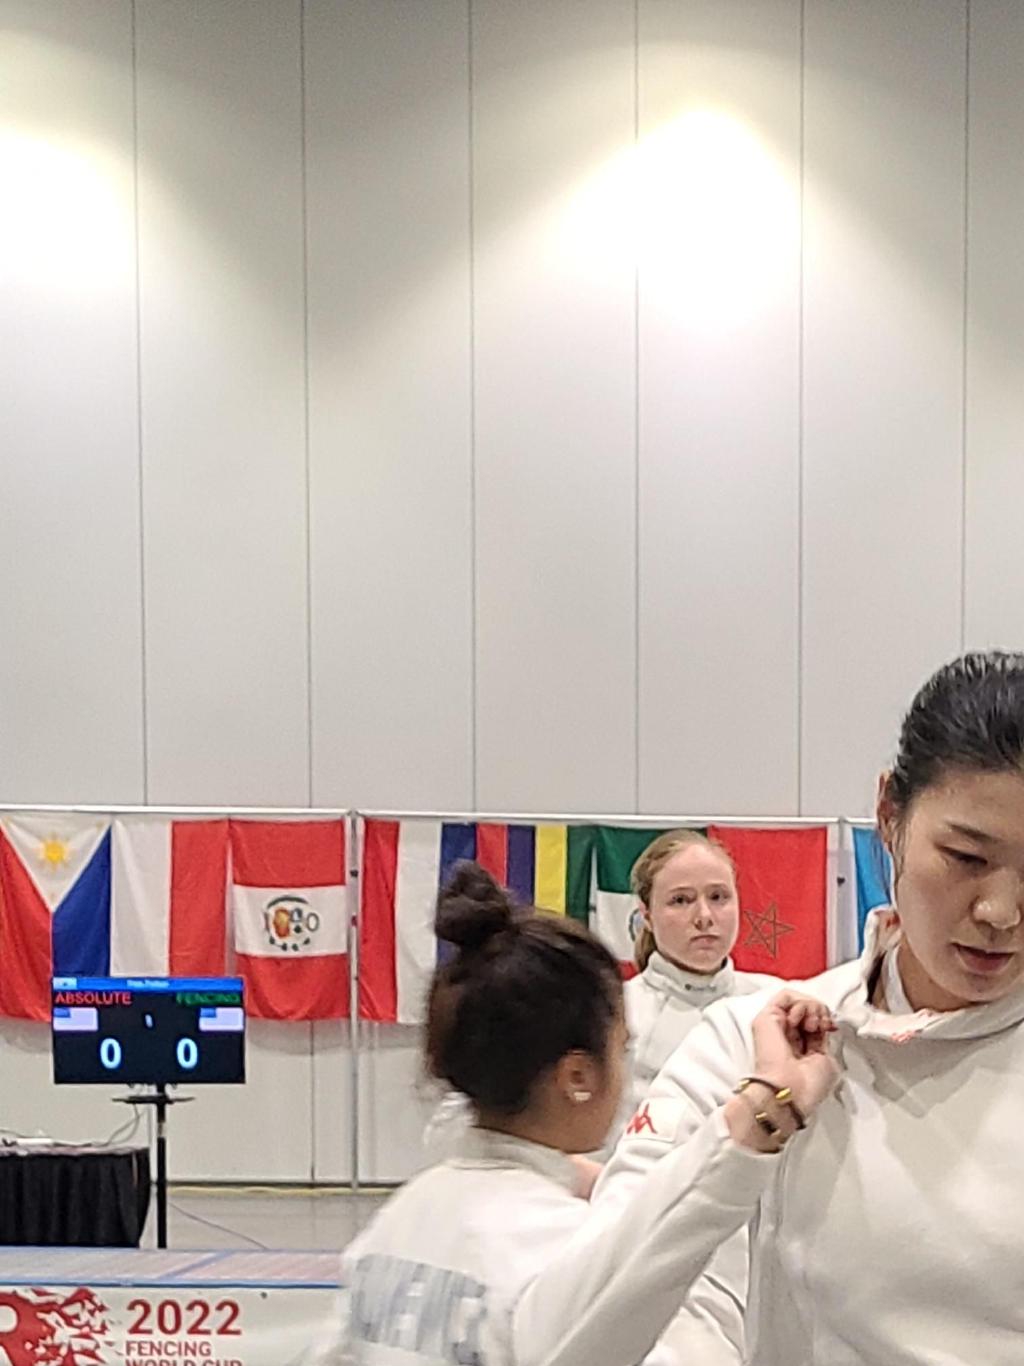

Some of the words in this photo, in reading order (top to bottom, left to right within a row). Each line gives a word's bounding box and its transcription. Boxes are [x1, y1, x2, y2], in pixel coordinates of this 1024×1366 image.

[54, 991, 132, 1005] ABSOLUTE
[100, 1038, 121, 1069] 0
[177, 1038, 198, 1069] 0
[126, 1299, 242, 1336] 2022
[125, 1341, 212, 1357] FENCING
